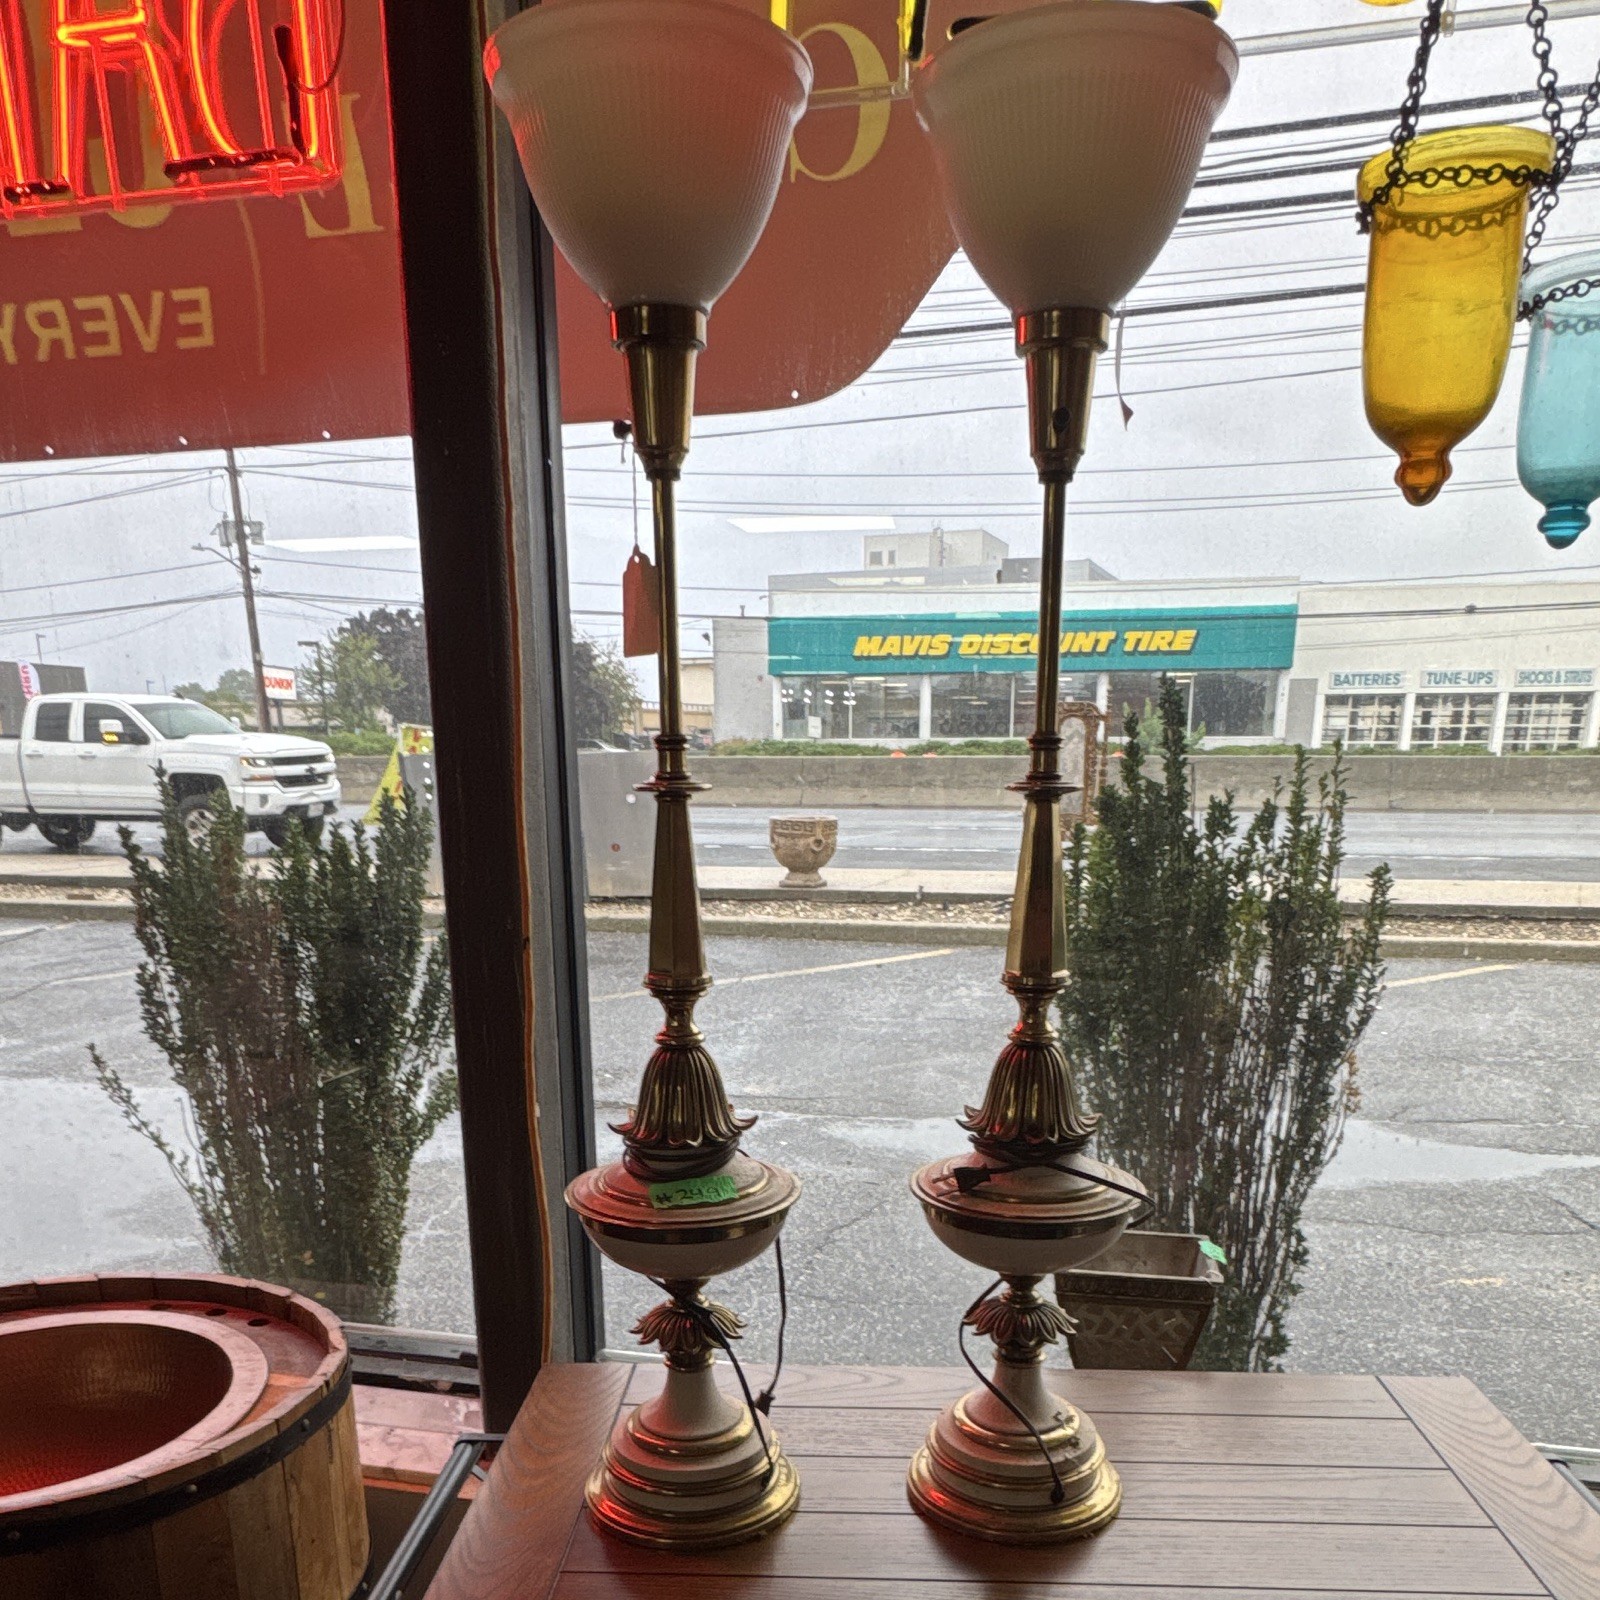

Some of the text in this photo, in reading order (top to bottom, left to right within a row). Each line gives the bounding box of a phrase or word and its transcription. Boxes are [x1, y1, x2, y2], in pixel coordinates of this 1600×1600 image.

[852, 634, 953, 659] MAVIS
[1123, 629, 1198, 654] TIRE
[1332, 672, 1402, 687] BATTERIES
[1426, 671, 1495, 685] TUNE-UPS
